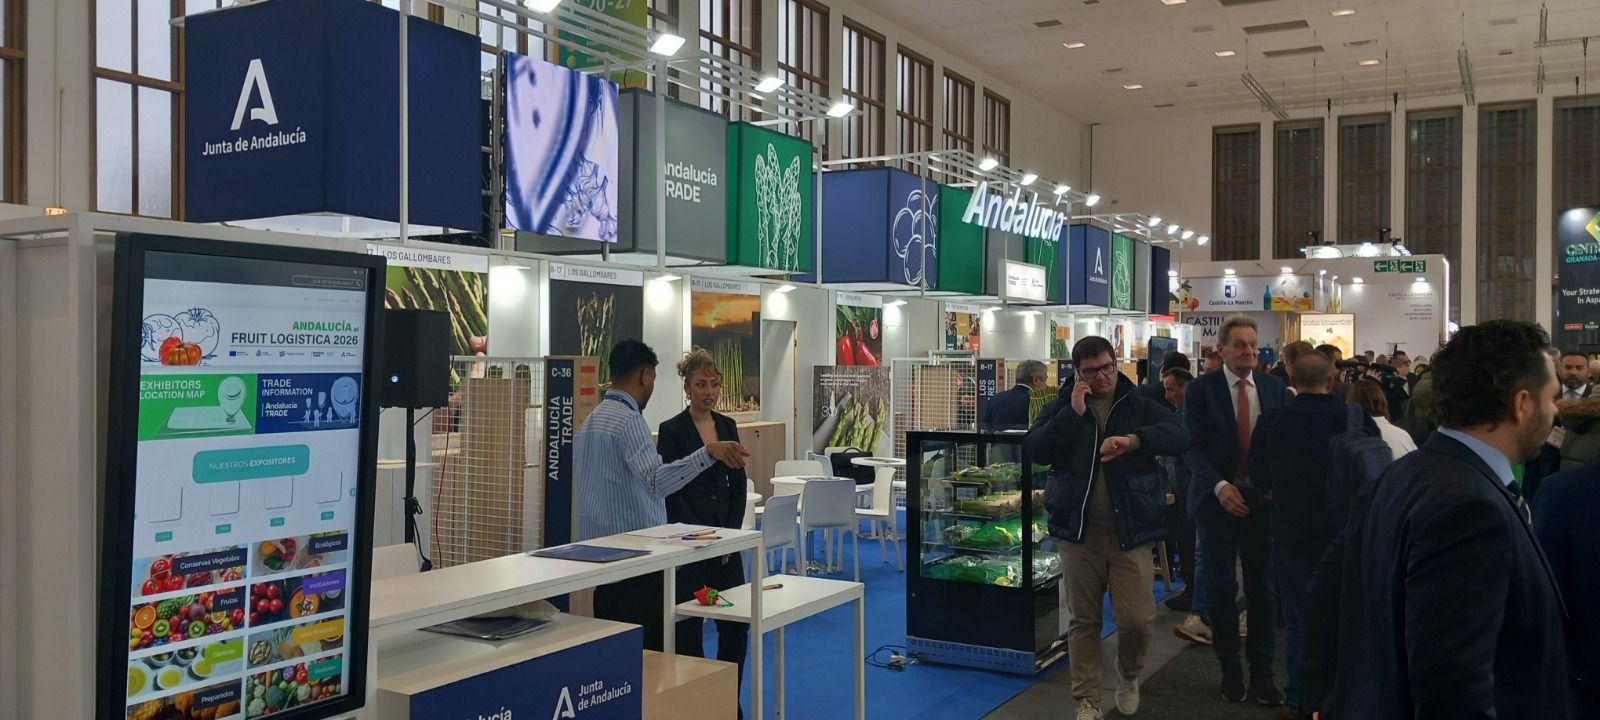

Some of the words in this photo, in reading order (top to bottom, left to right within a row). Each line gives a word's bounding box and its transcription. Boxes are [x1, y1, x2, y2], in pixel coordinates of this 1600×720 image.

[202, 142, 232, 155] Junta
[234, 137, 248, 152] de
[250, 126, 307, 150] Andalucía
[664, 161, 717, 186] ndalucía
[664, 179, 701, 202] RADE
[962, 180, 1064, 242] Andalucía
[398, 252, 452, 265] GALLOMBARES
[1566, 255, 1597, 263] GRANADA
[567, 268, 578, 277] LOS
[292, 320, 352, 332] ANDALUCÍA
[231, 332, 267, 344] FRUIT
[270, 334, 331, 345] LOGISTICA
[333, 335, 359, 345] 2026
[551, 368, 572, 378] C-36
[140, 380, 201, 390] EXHIBITORS
[262, 379, 291, 388] TRADE
[139, 391, 185, 400] LOCATION
[187, 390, 206, 399] MAP
[262, 387, 314, 397] INFORMATION
[265, 409, 288, 418] TRADE
[562, 396, 573, 446] TRADE
[548, 396, 560, 480] ANDALUCÍA
[208, 460, 248, 470] NUESTROS
[249, 456, 296, 467] EXPOSITORES
[180, 558, 211, 569] Conservas
[212, 554, 240, 566] Vegetales
[220, 597, 238, 606] Frutas
[578, 680, 603, 697] Junta
[201, 690, 234, 703] Preparados
[577, 698, 589, 711] de
[590, 682, 632, 706] Andalucía
